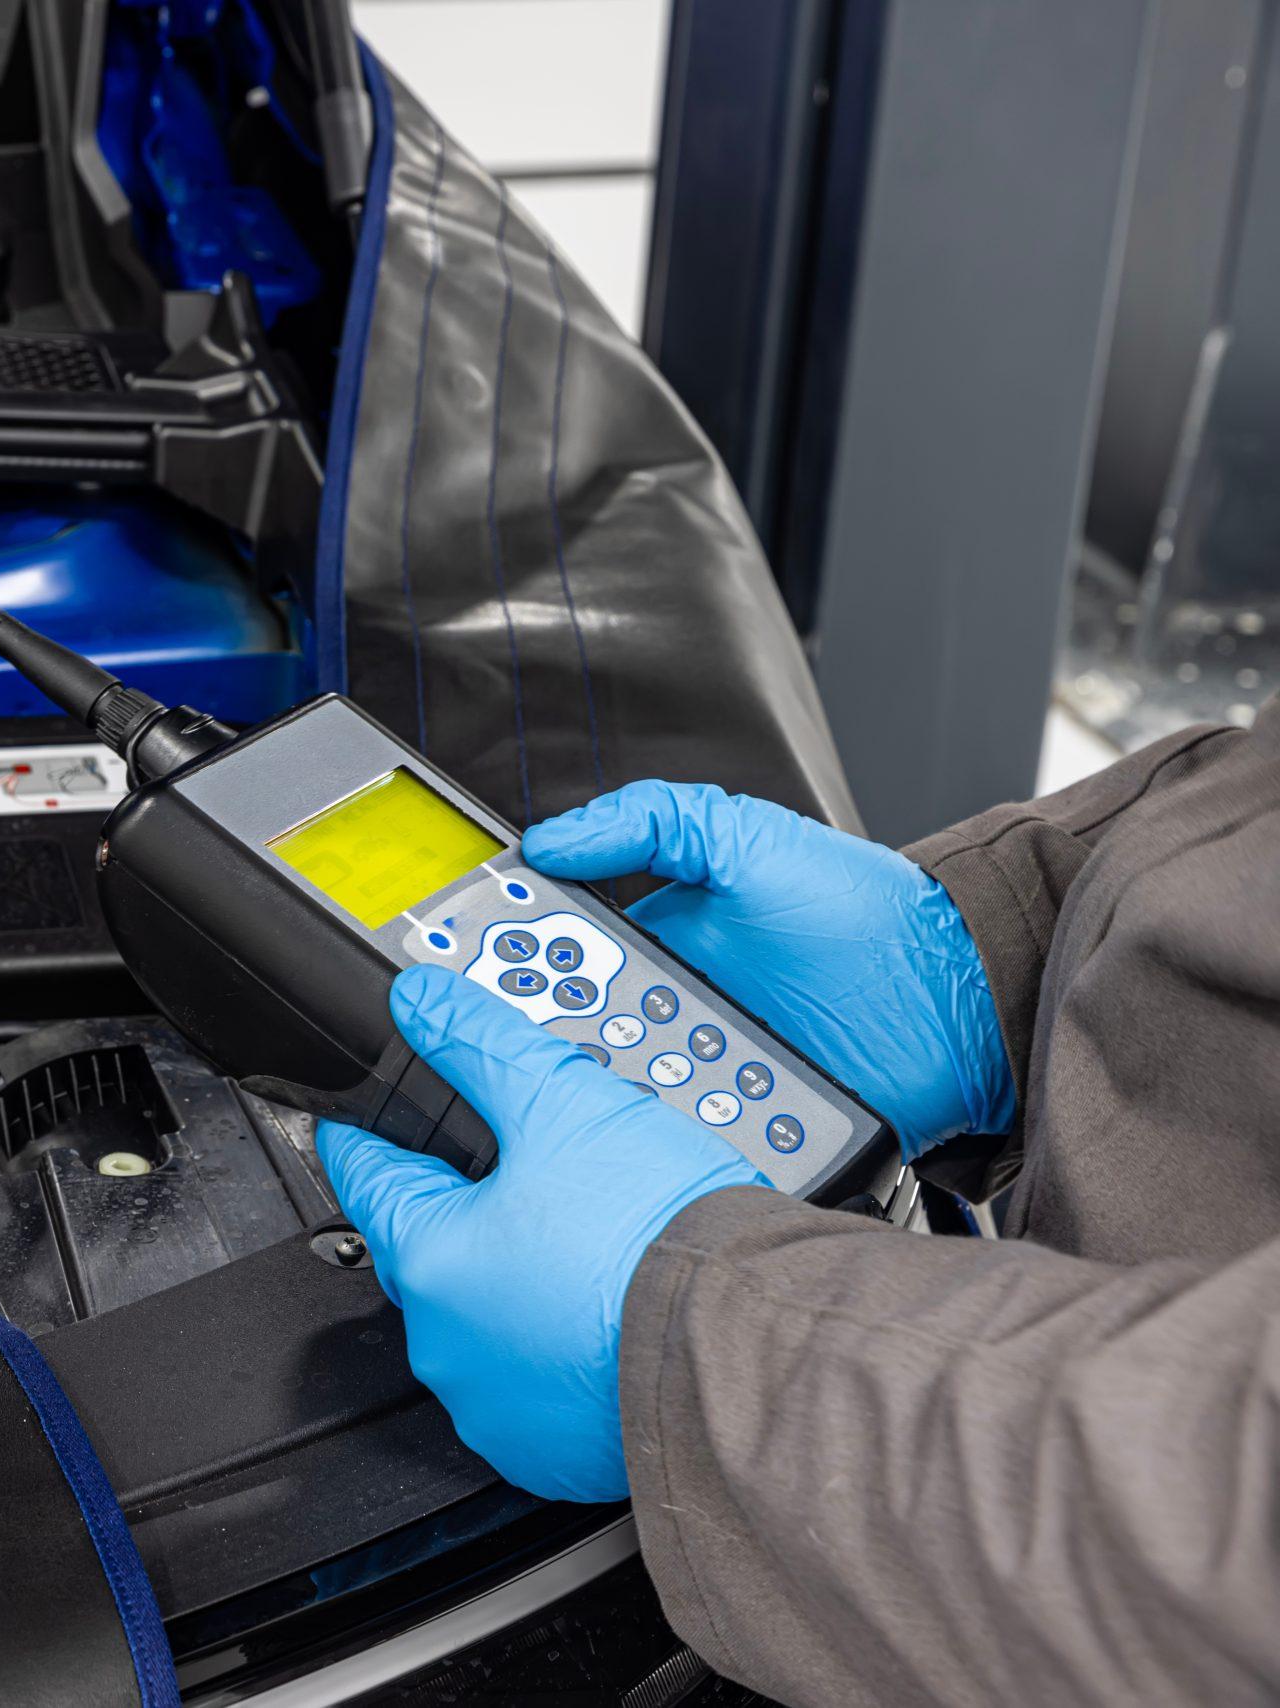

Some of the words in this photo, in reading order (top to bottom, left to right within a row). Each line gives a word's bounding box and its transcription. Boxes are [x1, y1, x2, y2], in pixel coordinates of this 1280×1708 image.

[649, 994, 663, 1005] 3
[659, 1002, 673, 1016] def
[611, 1021, 625, 1032] 2
[622, 1030, 637, 1042] abc
[696, 1032, 710, 1043] 6
[702, 1042, 720, 1056] mno
[659, 1059, 672, 1070] 5
[743, 1070, 757, 1081] 9
[749, 1079, 769, 1094] wxyz
[707, 1098, 721, 1109] 8
[718, 1107, 732, 1118] tuv
[773, 1123, 787, 1134] 0
